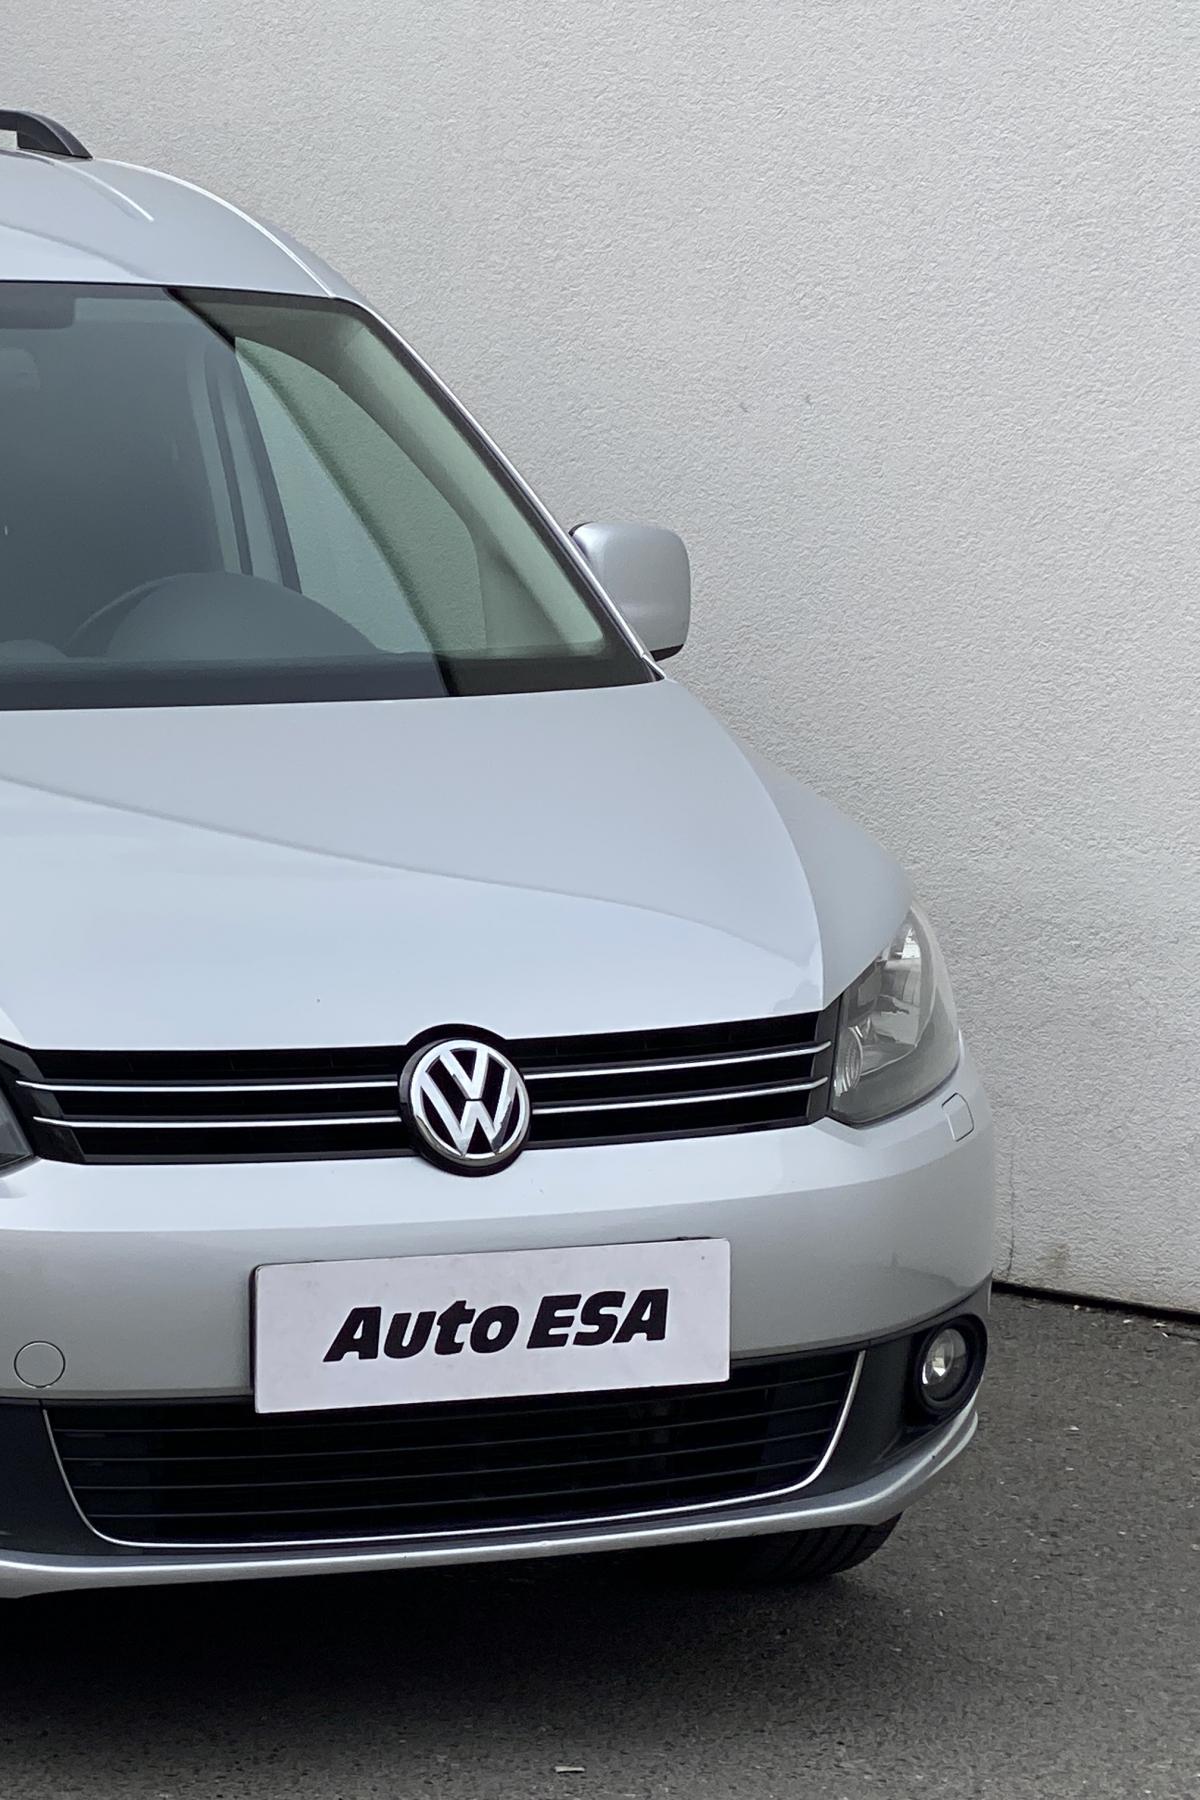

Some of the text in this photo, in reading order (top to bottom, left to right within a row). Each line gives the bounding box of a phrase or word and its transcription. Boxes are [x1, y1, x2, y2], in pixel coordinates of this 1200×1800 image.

[413, 1042, 523, 1158] VW
[322, 1288, 669, 1363] Auto ESA
